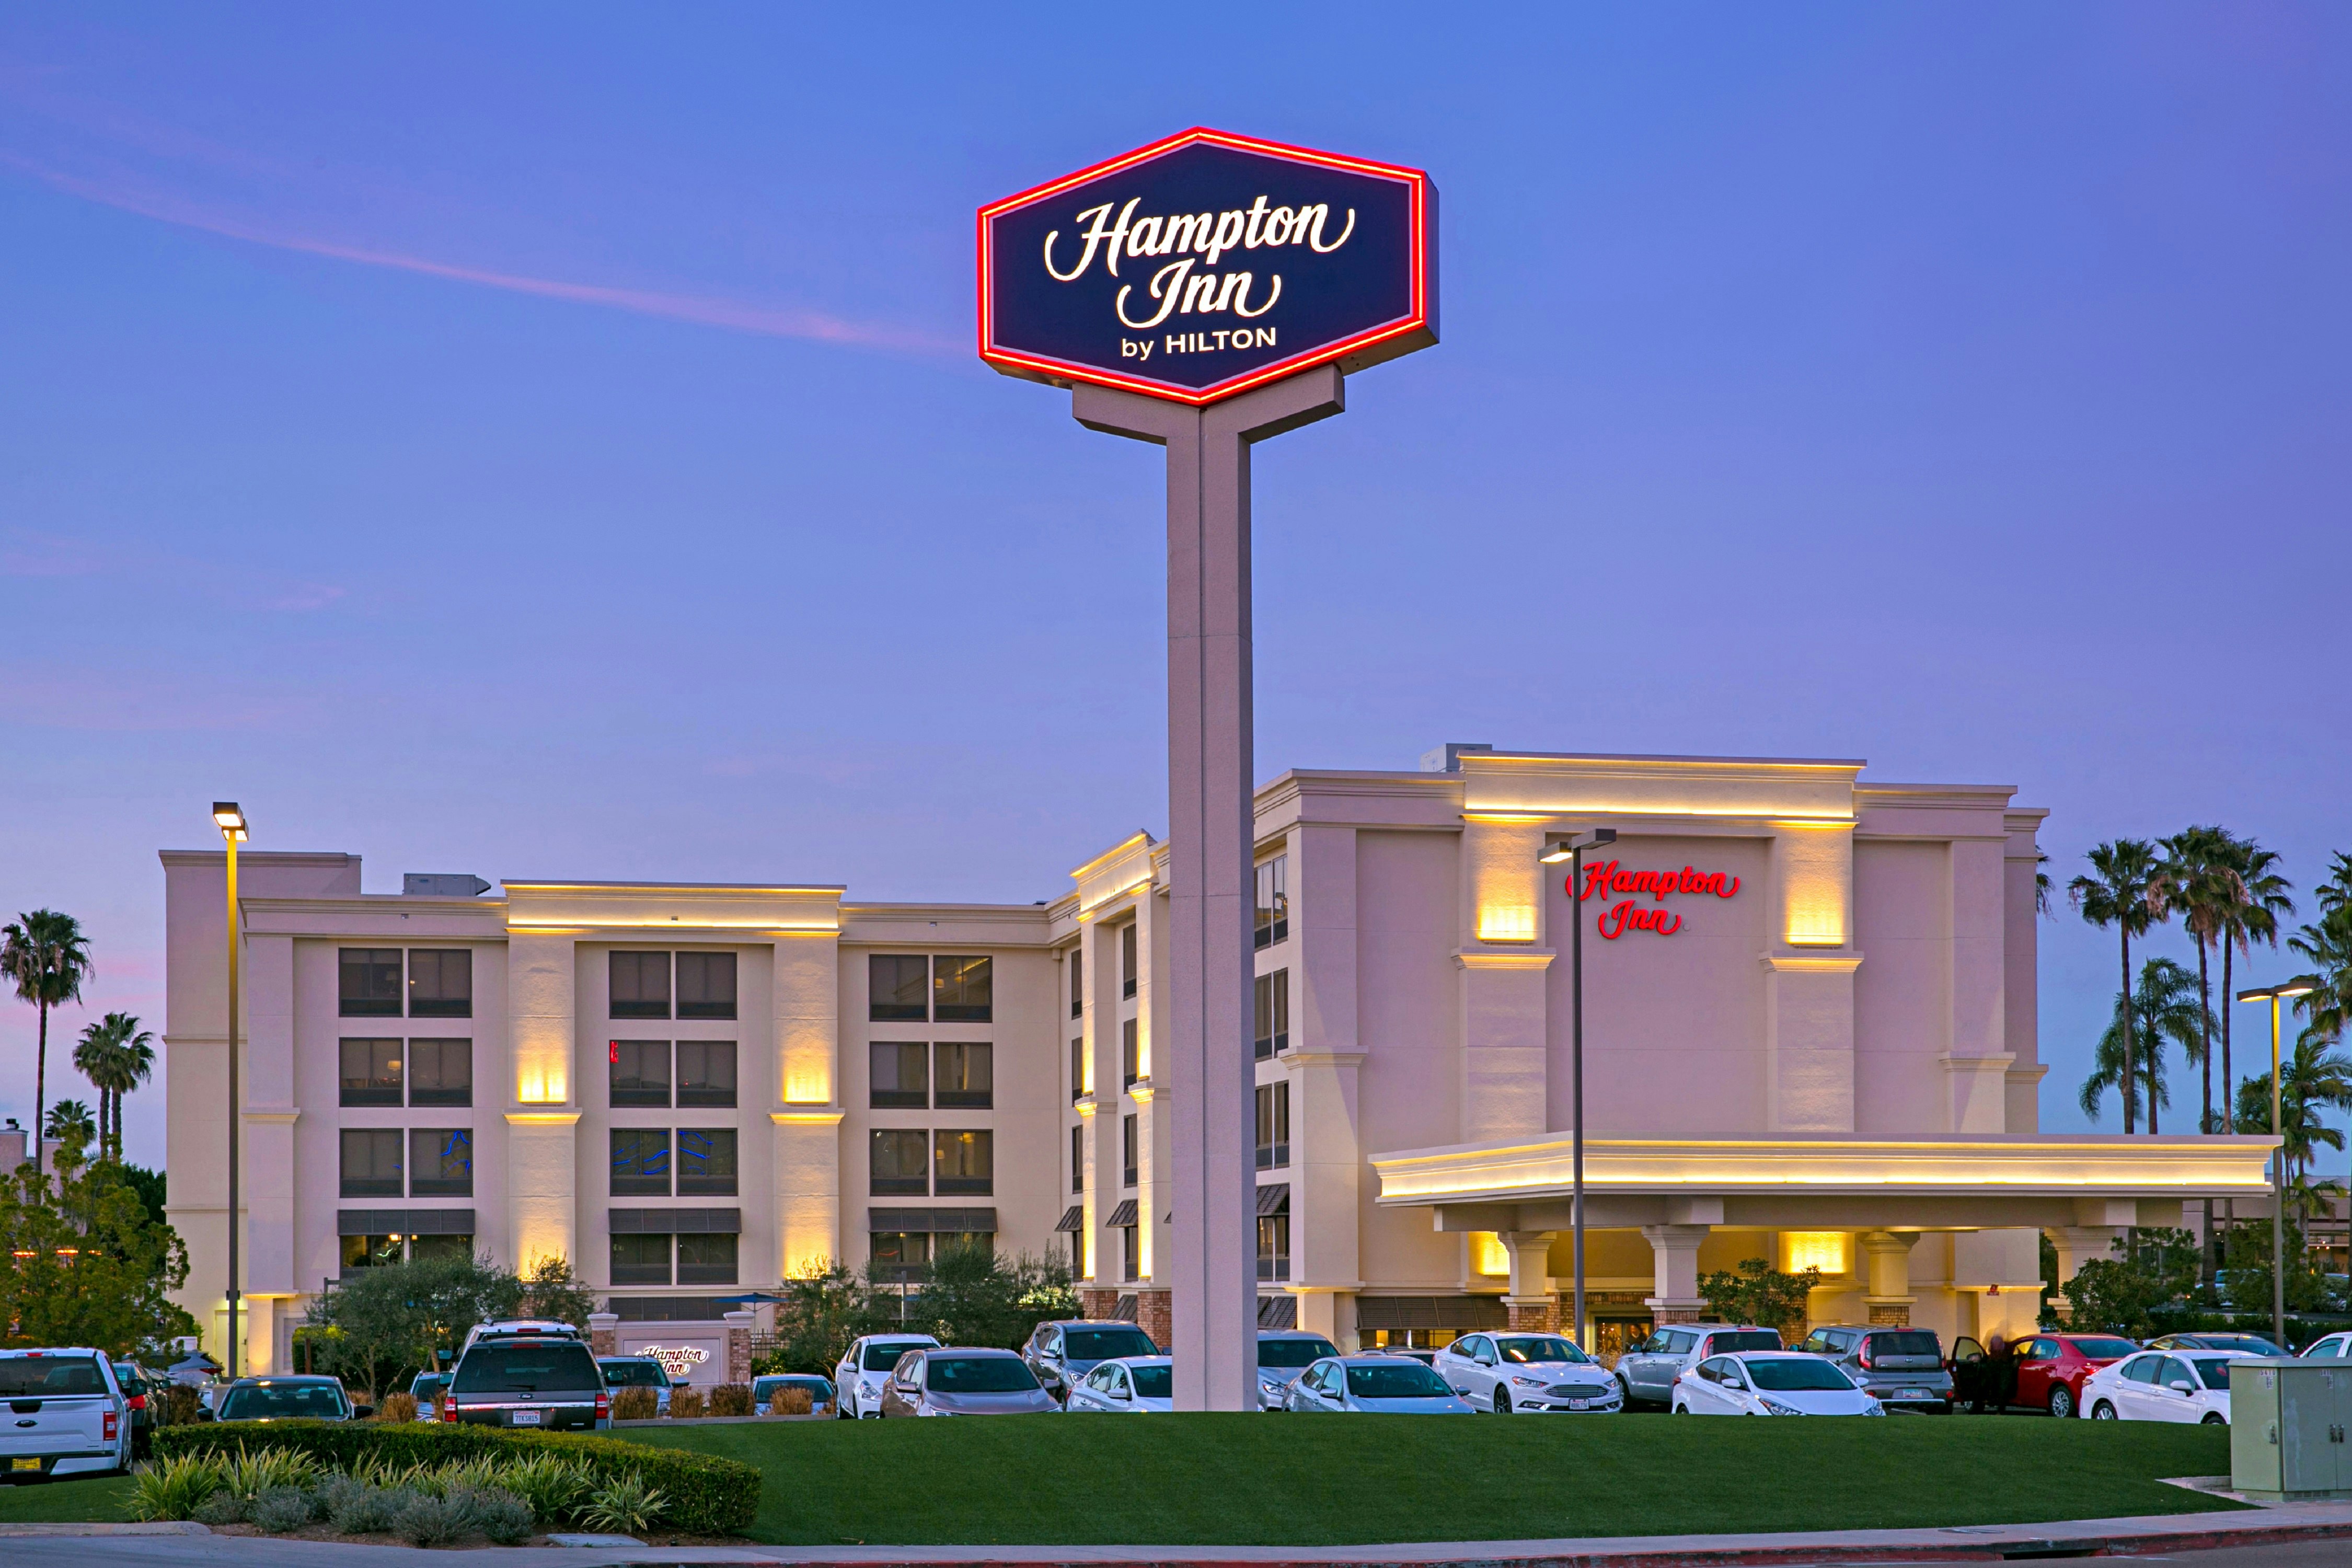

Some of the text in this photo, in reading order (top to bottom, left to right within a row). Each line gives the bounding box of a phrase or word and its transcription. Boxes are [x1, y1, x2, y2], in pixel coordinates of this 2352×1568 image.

[1045, 195, 1355, 281] Hampton
[1117, 258, 1282, 328] Inn
[1122, 327, 1276, 361] by HILTON
[1565, 859, 1741, 901] Hampton
[1598, 900, 1682, 939] Inn
